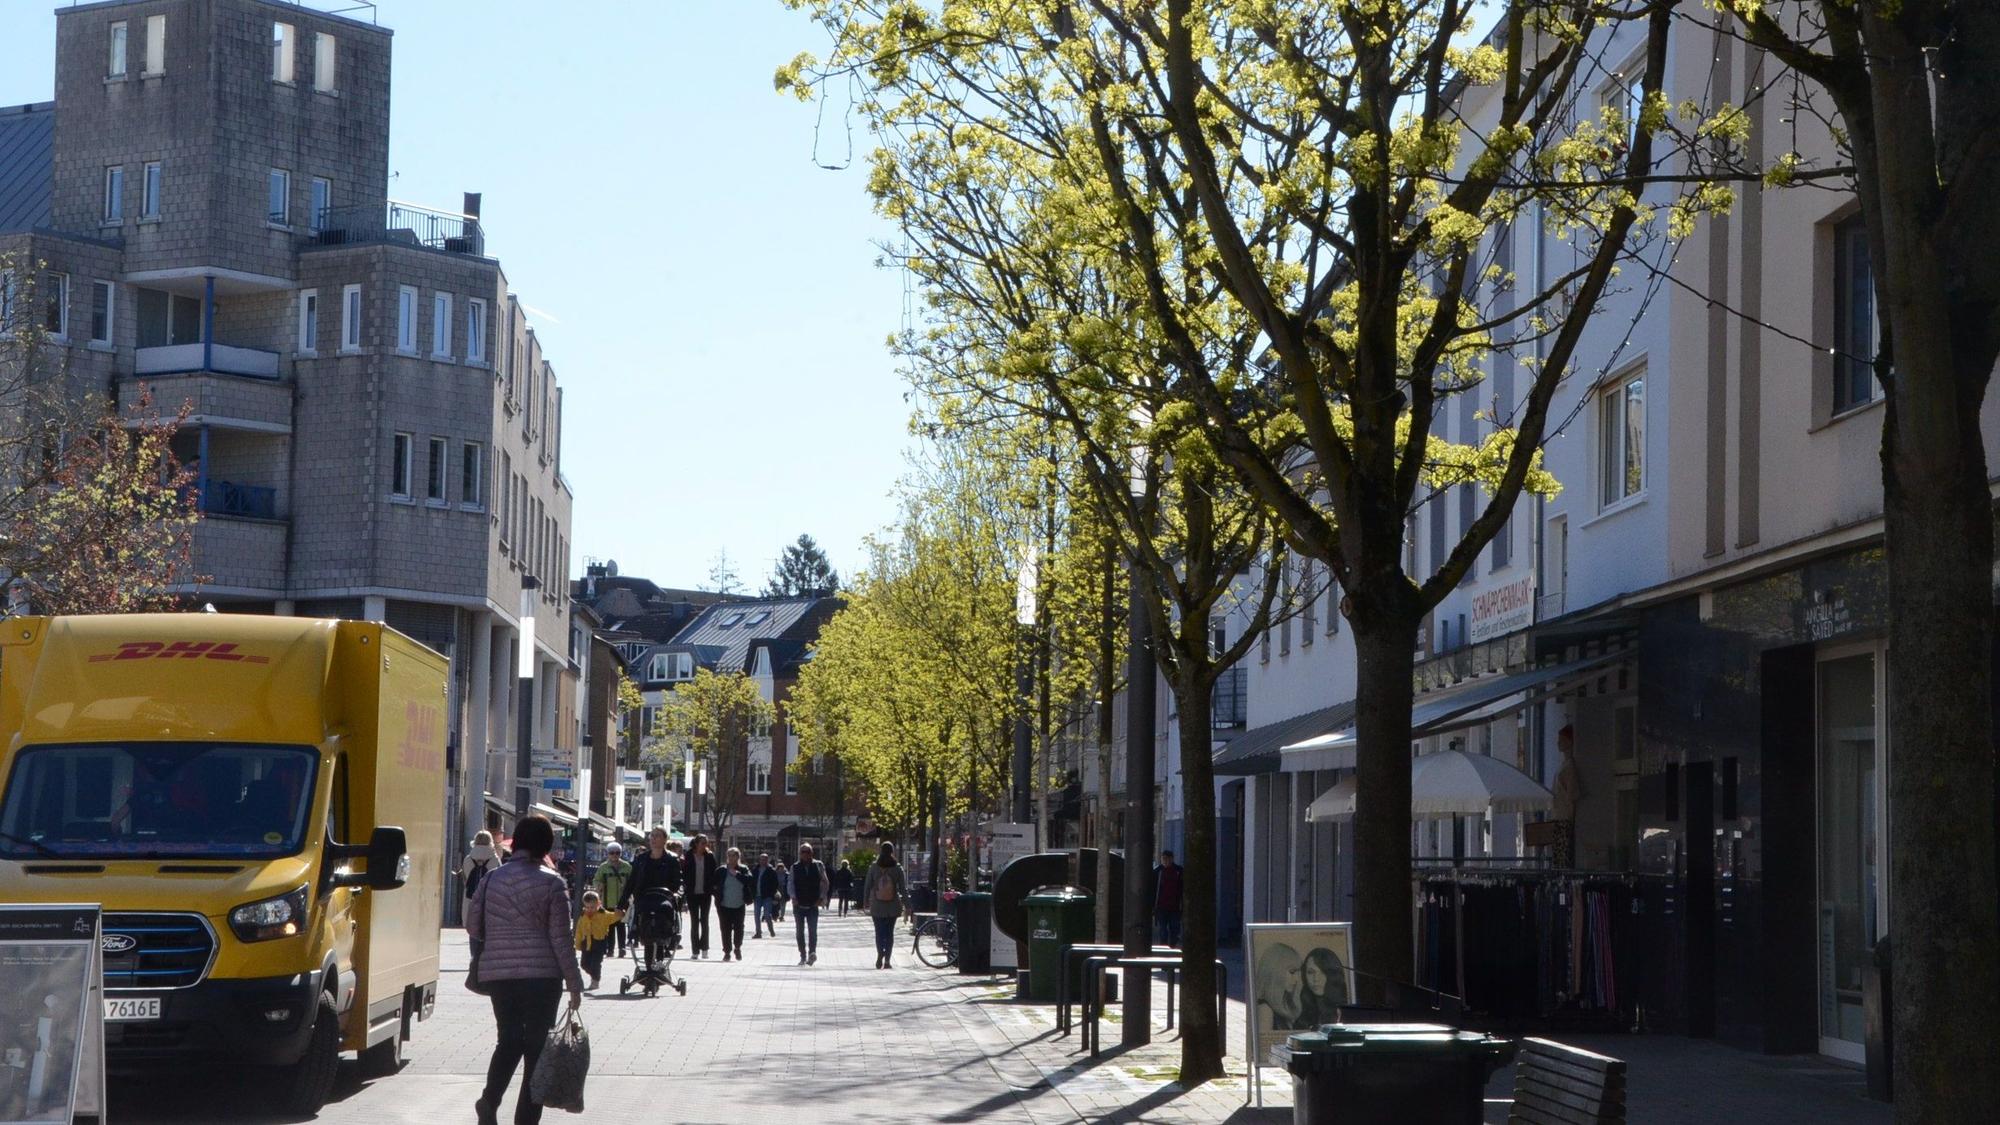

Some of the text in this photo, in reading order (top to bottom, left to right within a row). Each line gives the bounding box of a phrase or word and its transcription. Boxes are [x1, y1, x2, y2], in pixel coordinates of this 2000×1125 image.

[113, 641, 243, 660] DHL
[102, 936, 127, 949] Ford
[109, 1000, 158, 1017] 7616E
